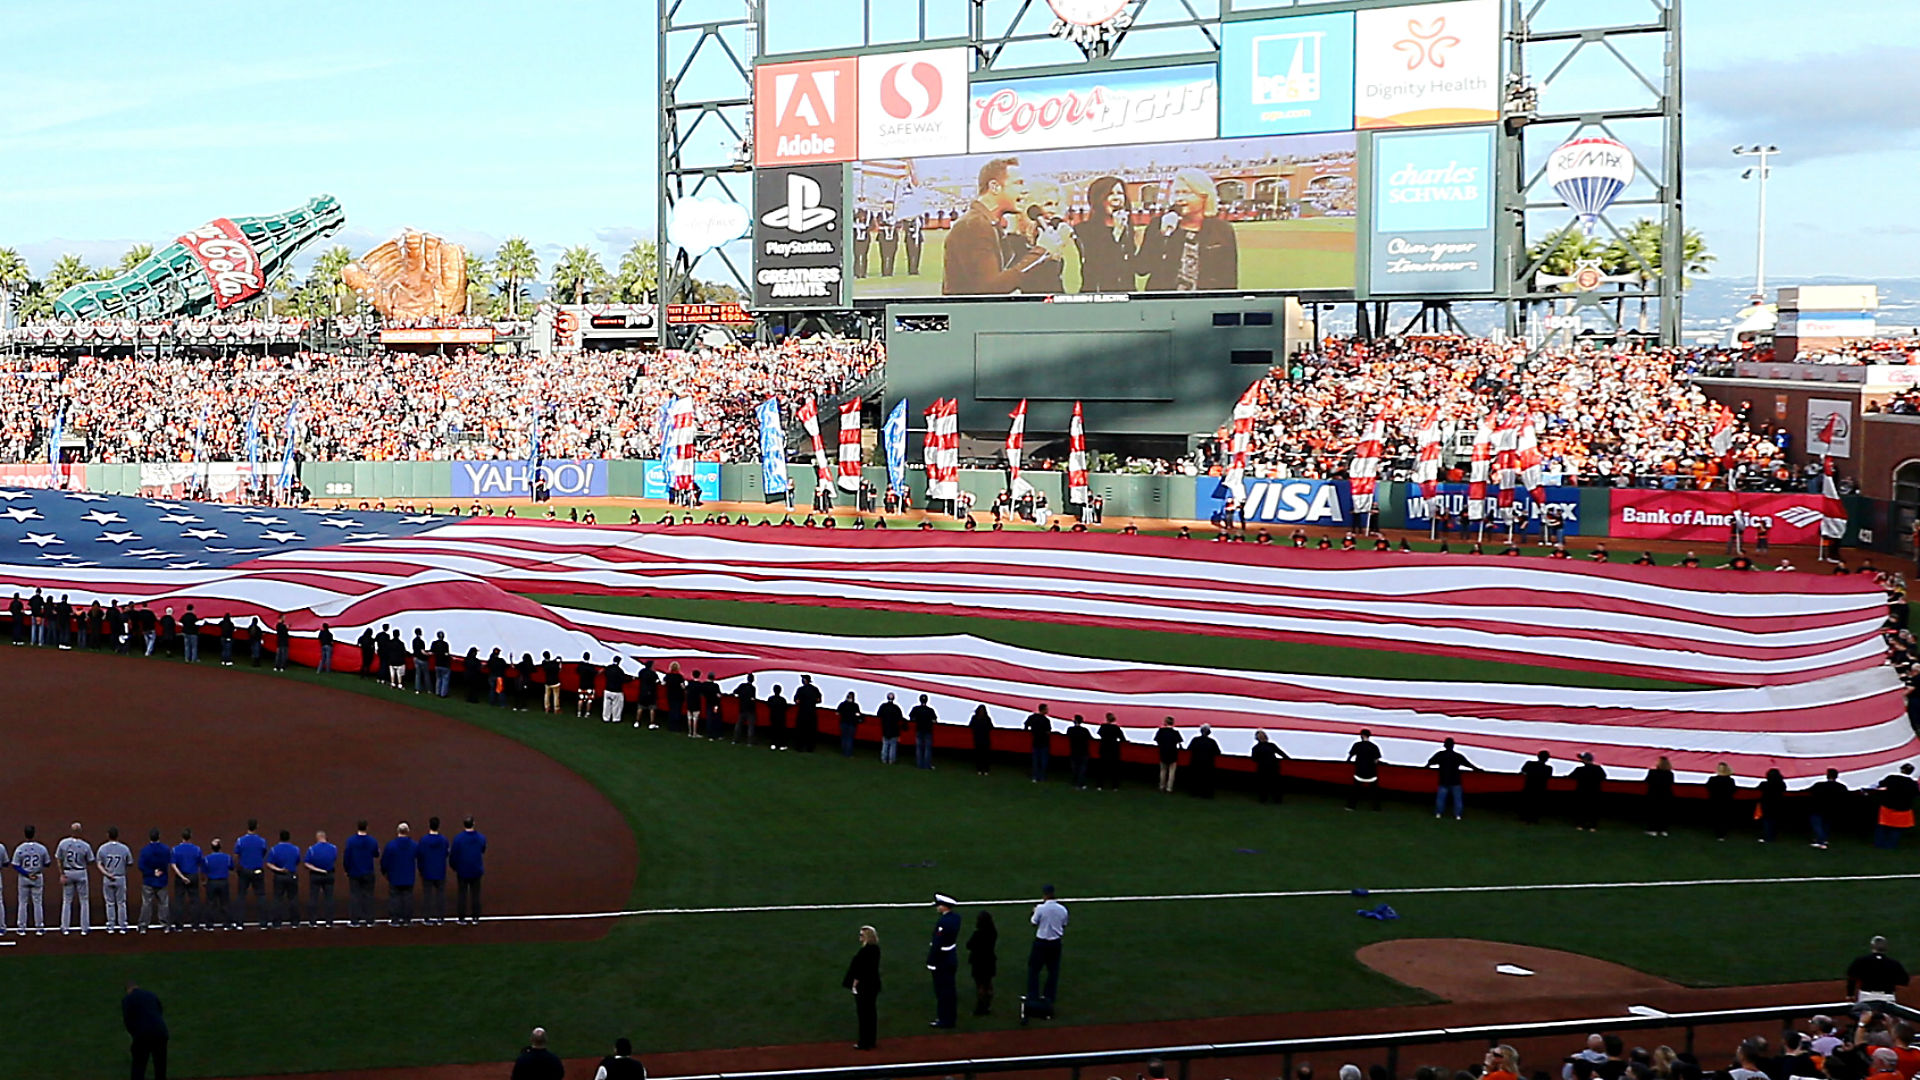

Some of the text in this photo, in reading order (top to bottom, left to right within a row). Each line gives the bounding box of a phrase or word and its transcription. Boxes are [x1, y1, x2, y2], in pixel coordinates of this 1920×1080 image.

[1048, 9, 1133, 44] GIANTS
[1366, 77, 1487, 99] Dignity Health
[976, 80, 1213, 138] Coors LIGHT
[879, 122, 940, 137] SAFEWAY
[776, 133, 835, 156] Adobe
[1558, 150, 1623, 170] RE/MAX
[1390, 160, 1479, 185] charles
[1389, 186, 1478, 203] SCHWAB
[758, 268, 840, 284] GREATNESS
[684, 306, 711, 314] FAIR
[1243, 483, 1343, 521] VISA
[1407, 494, 1464, 519] WRLD
[1622, 507, 1773, 528] Bank of Ameica
[23, 854, 40, 867] 22
[66, 850, 79, 864] 21
[106, 855, 122, 868] 77
